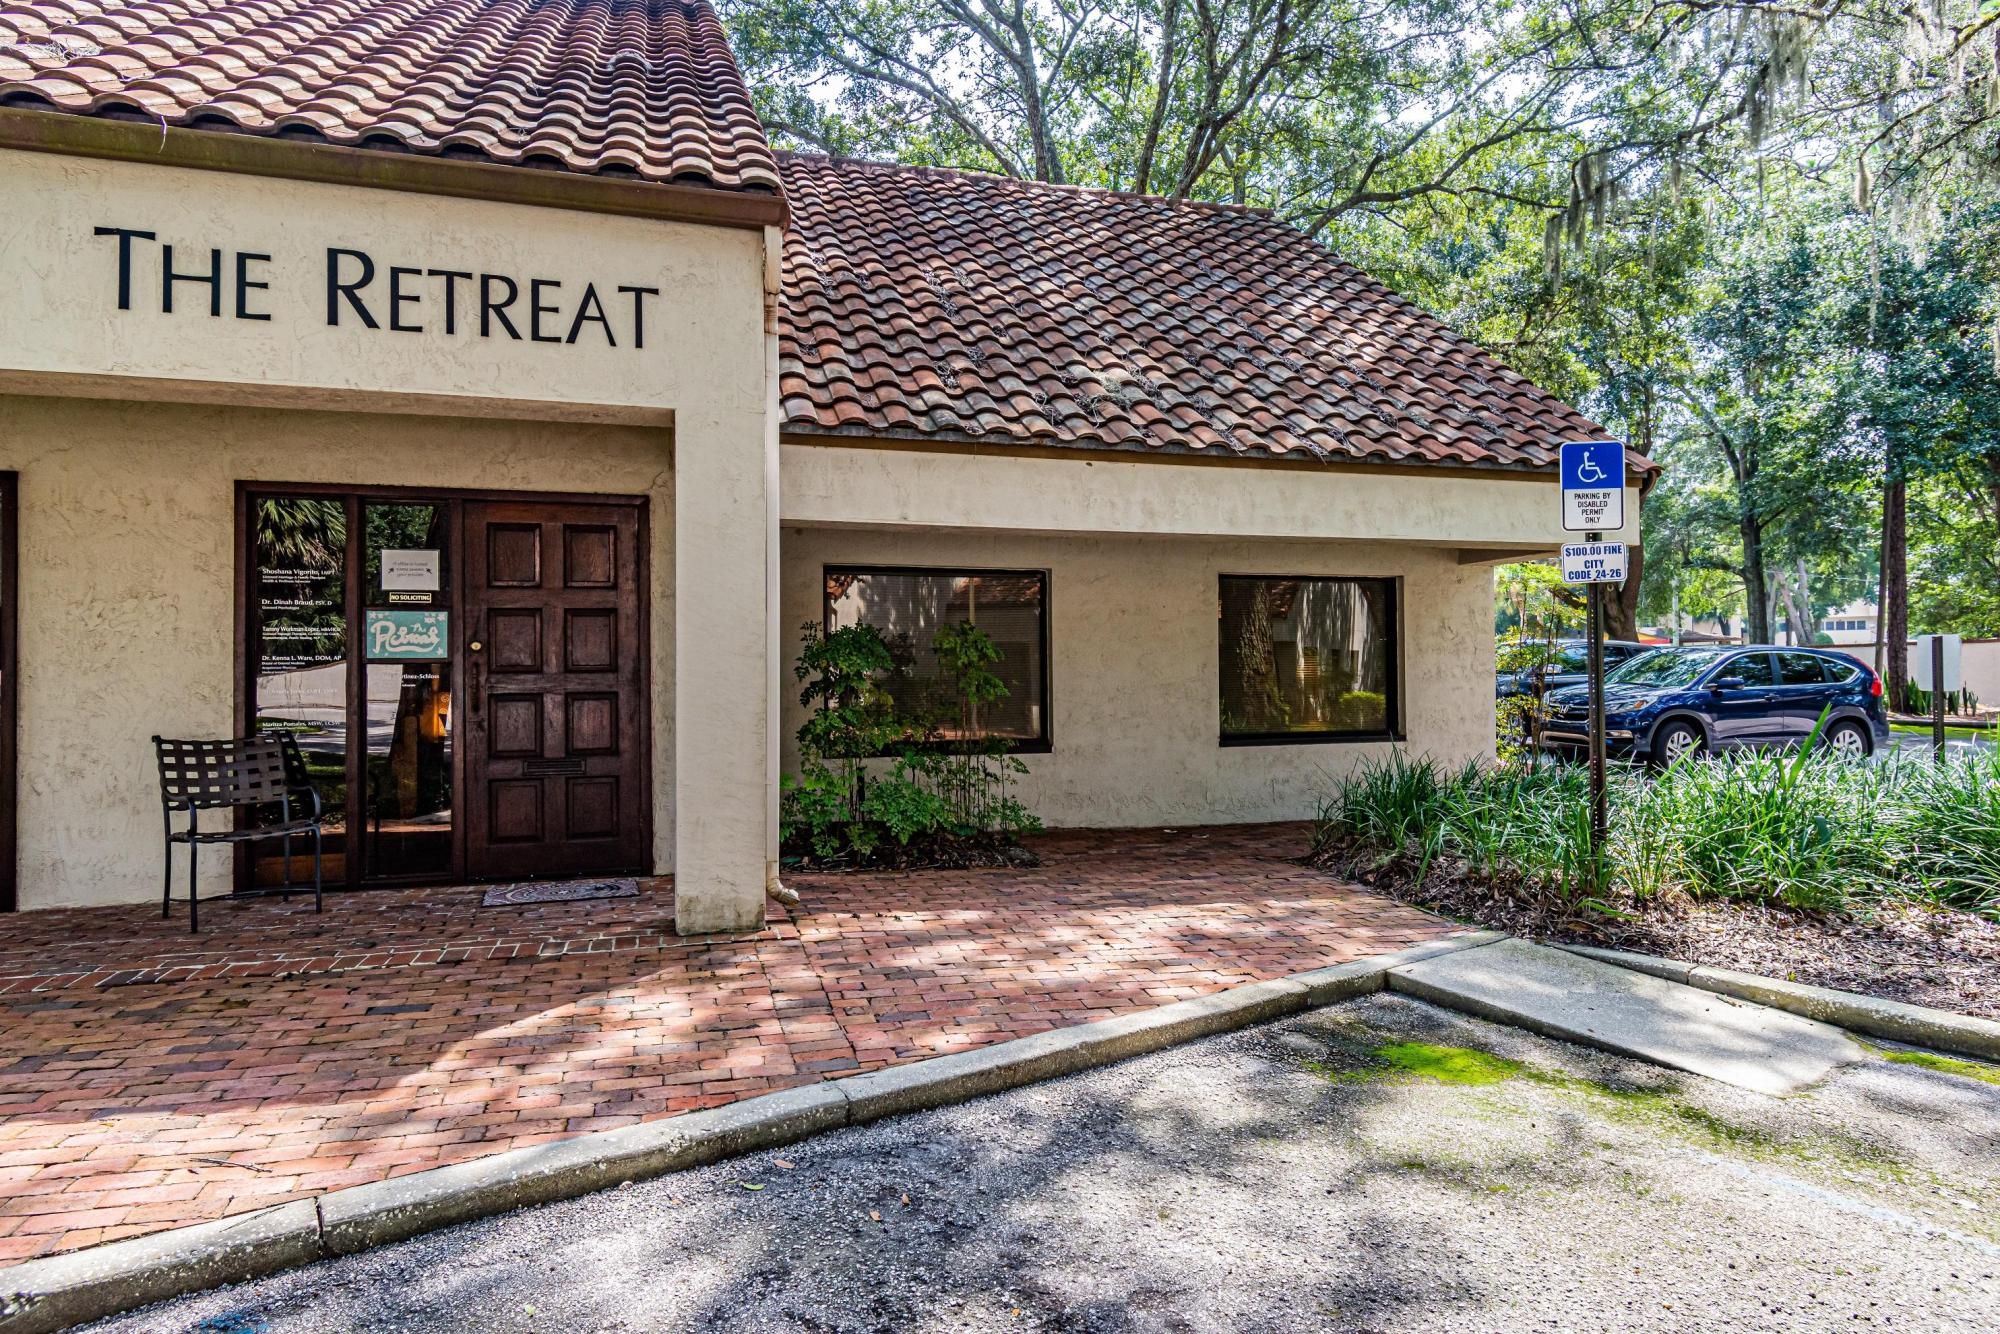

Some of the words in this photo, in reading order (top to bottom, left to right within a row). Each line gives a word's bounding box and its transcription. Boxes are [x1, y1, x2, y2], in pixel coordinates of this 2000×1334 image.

[94, 226, 272, 321] THE
[327, 247, 660, 349] RETREAT
[1602, 492, 1611, 500] BY
[1577, 500, 1608, 508] DISABLED
[1581, 508, 1604, 516] PERMIT
[1585, 516, 1600, 524] ONLY
[1565, 546, 1602, 557] $100.00
[1603, 545, 1622, 554] FINE
[1584, 560, 1604, 569] CITY
[1568, 570, 1591, 580] CODE
[1595, 568, 1622, 578] 24-26
